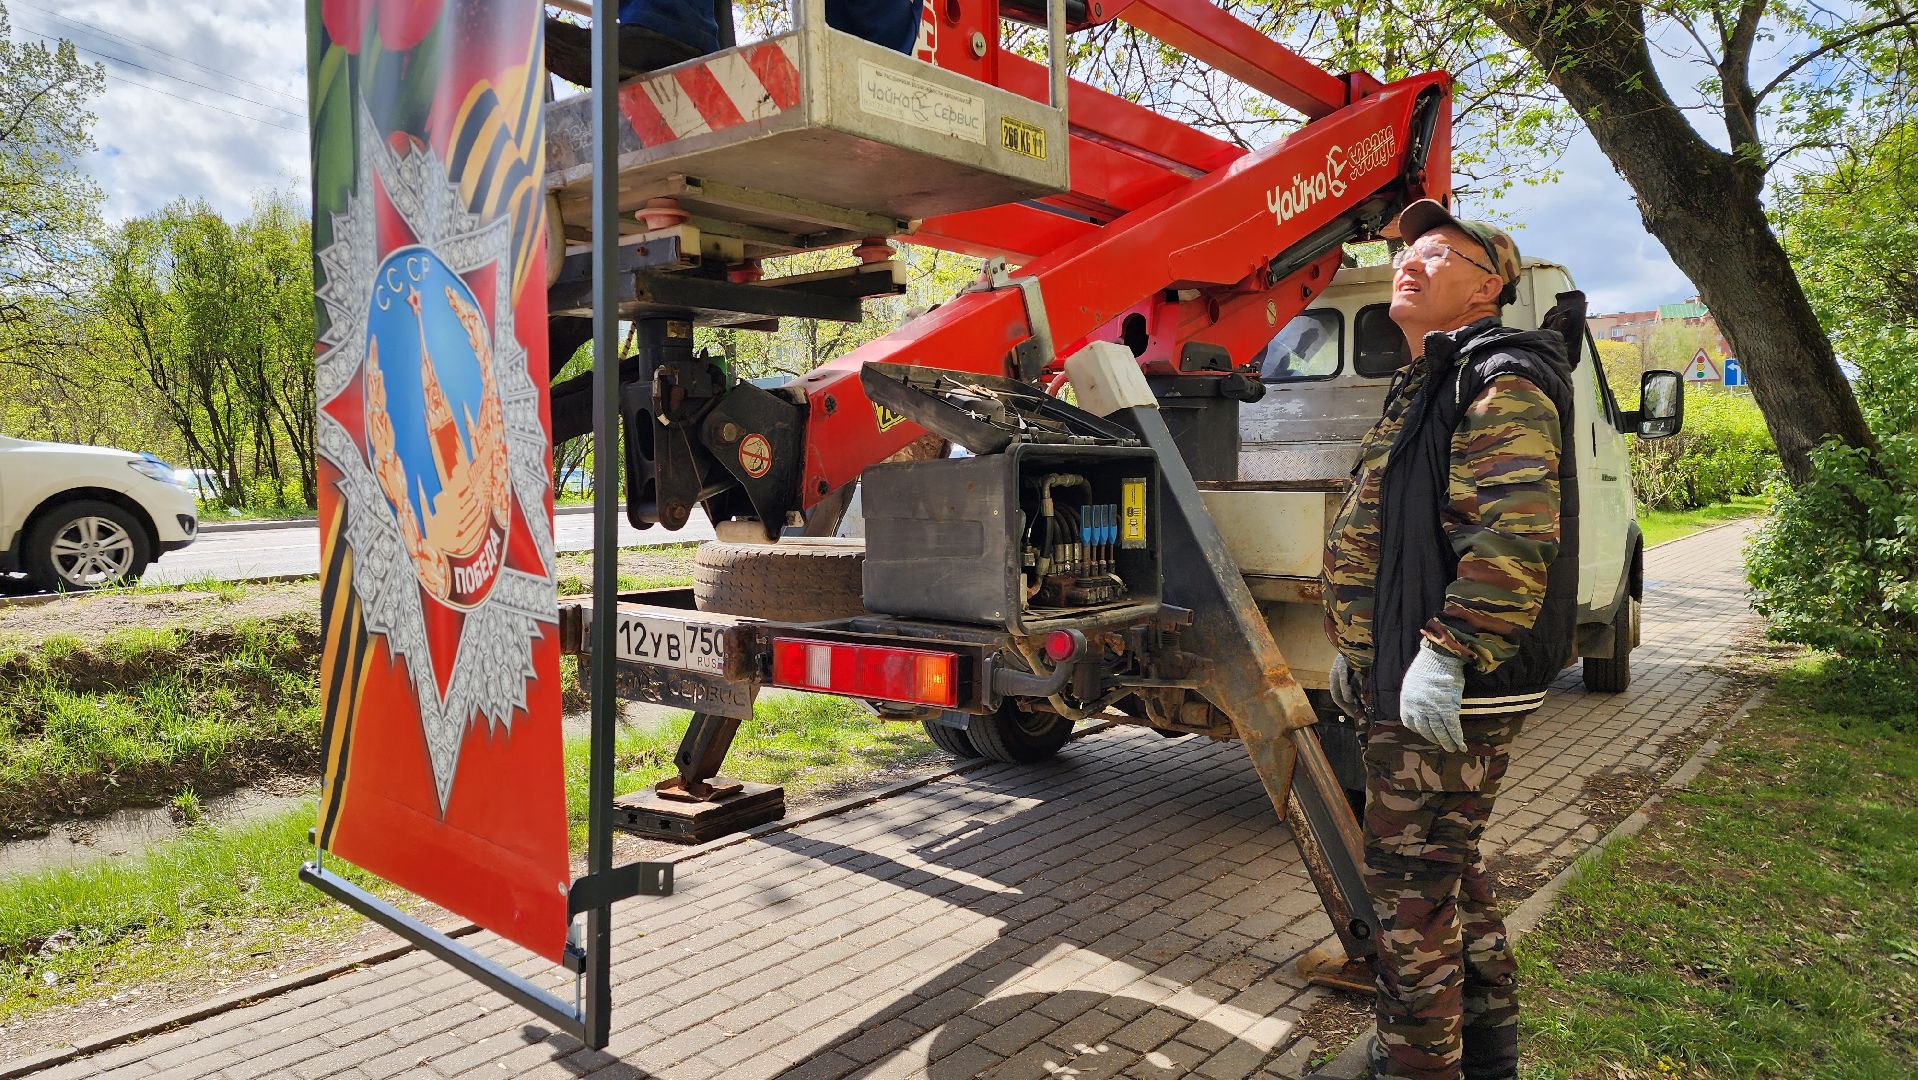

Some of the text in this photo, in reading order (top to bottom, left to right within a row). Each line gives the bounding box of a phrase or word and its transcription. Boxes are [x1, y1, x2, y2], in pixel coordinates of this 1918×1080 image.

[1266, 172, 1327, 226] Чайка
[376, 256, 430, 311] СССР
[453, 527, 501, 595] ПОБЕДА
[697, 656, 717, 668] RUS
